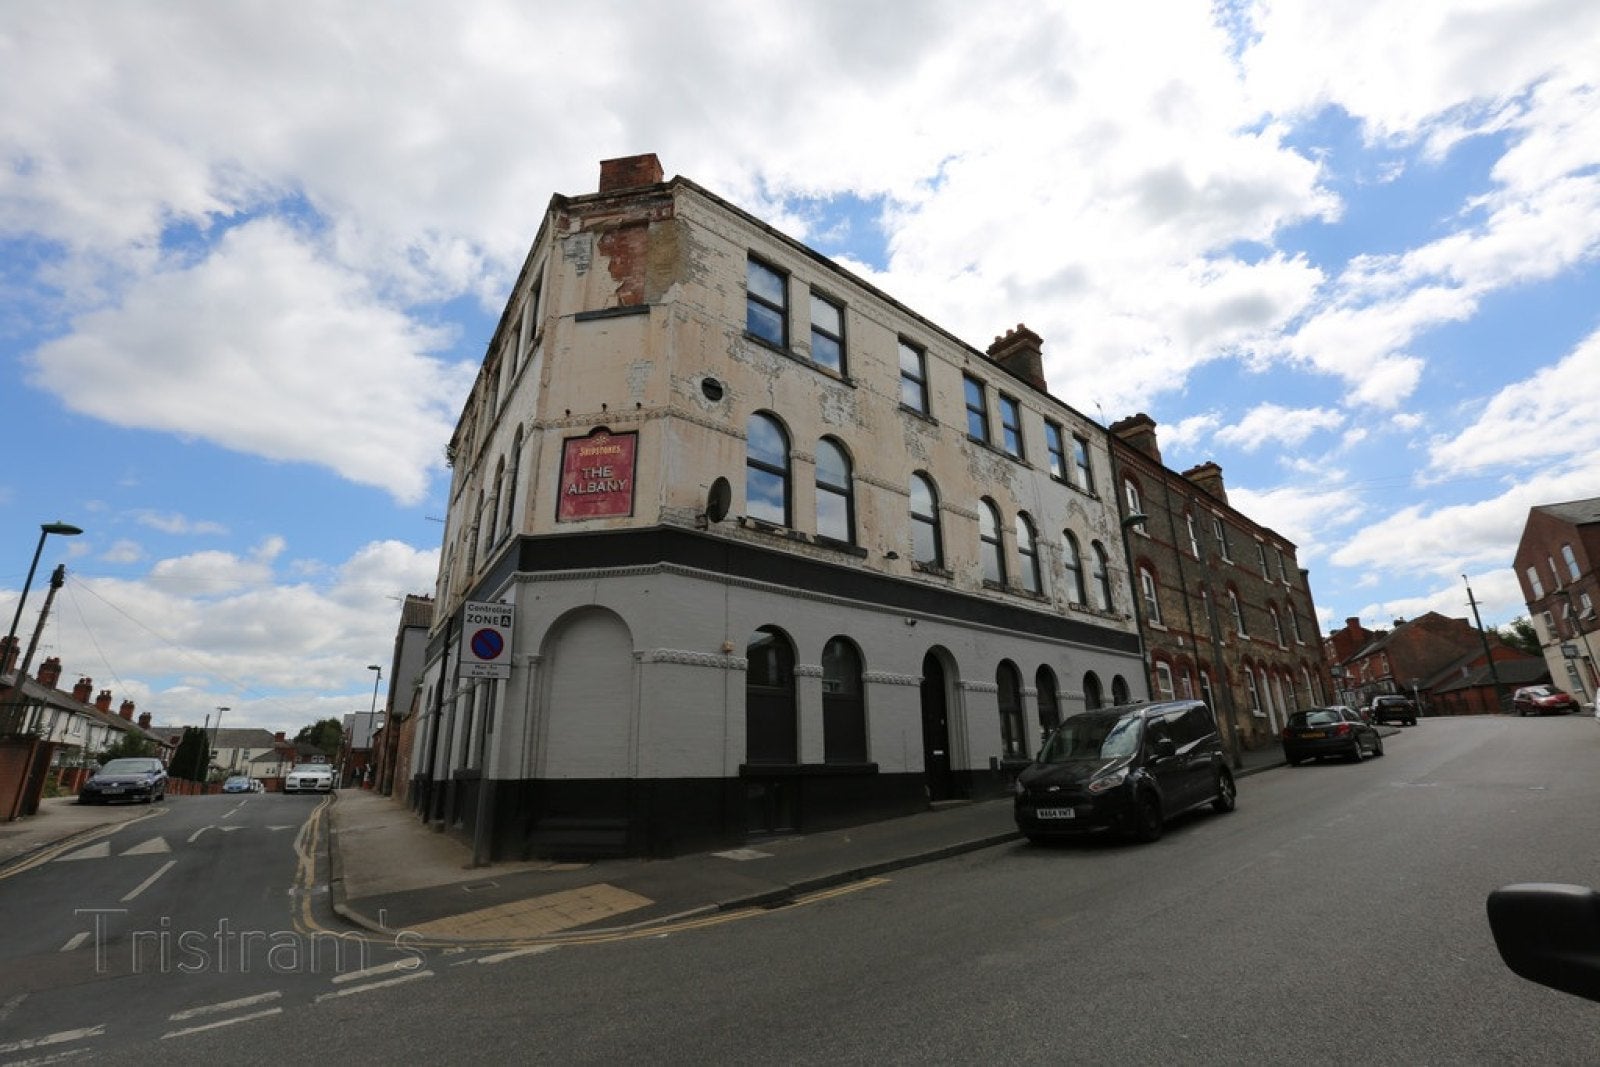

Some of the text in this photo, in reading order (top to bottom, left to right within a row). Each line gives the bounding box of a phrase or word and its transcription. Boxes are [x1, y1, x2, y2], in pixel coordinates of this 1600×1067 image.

[582, 465, 614, 479] THE
[568, 479, 627, 495] ALBANY
[468, 604, 512, 615] Controlled
[466, 613, 499, 625] ZONE
